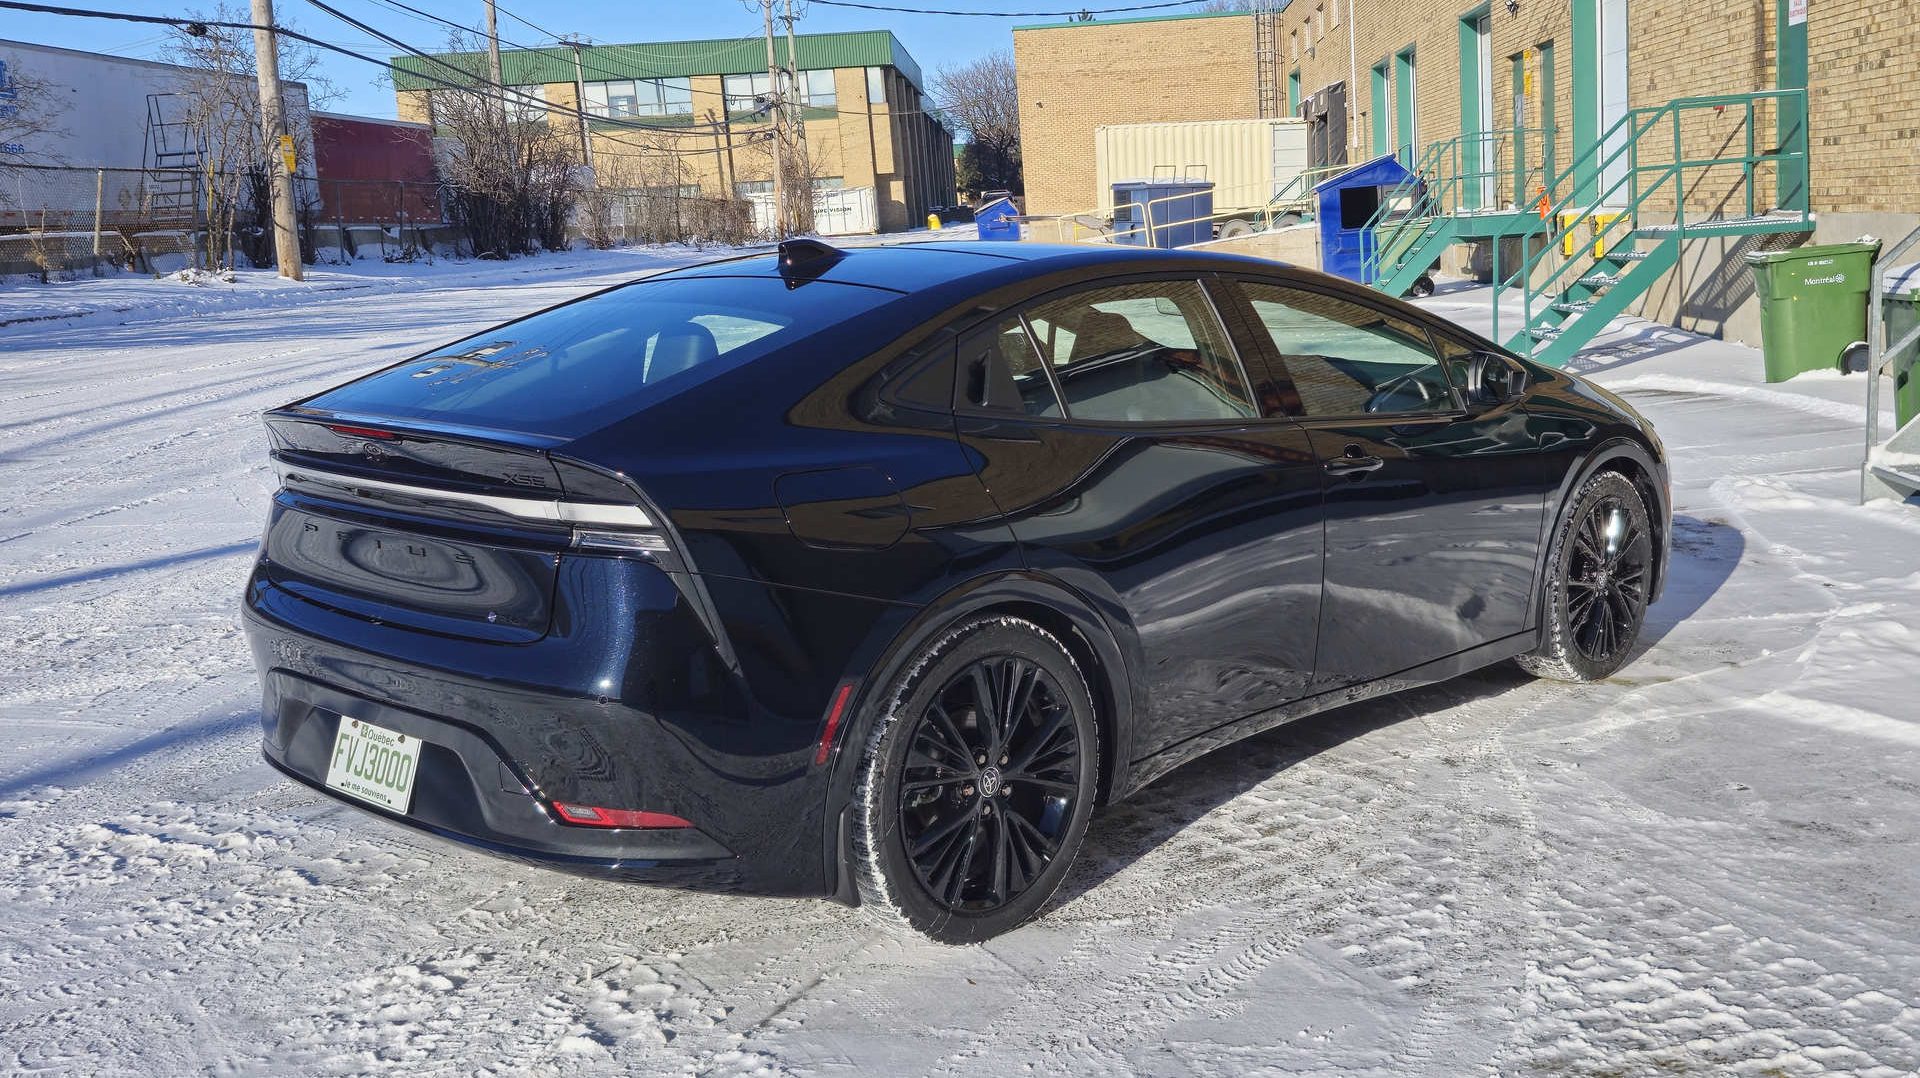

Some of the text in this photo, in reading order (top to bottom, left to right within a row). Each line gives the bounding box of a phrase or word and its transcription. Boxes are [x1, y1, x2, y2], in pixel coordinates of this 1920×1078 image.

[502, 472, 545, 488] XSE
[368, 729, 395, 747] Québec
[334, 733, 412, 793] FVJ3000
[361, 786, 387, 801] souviens
